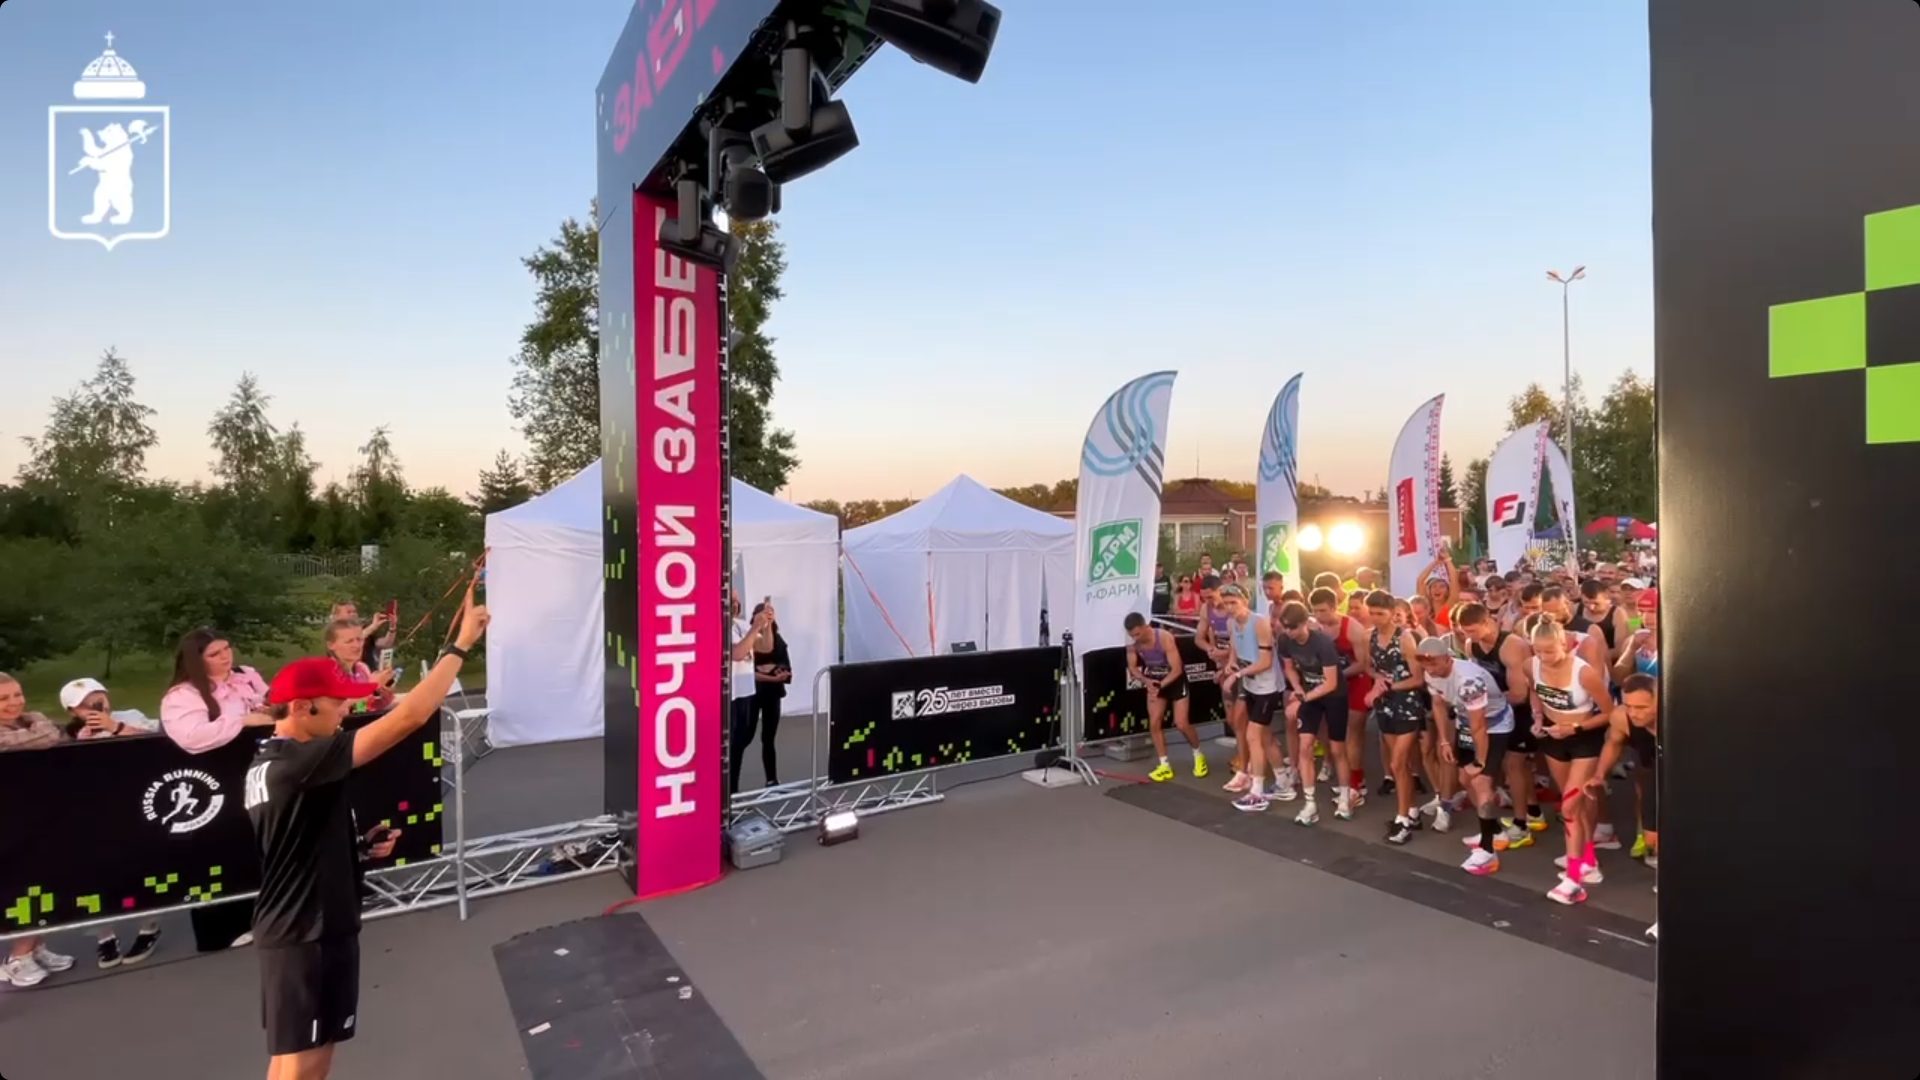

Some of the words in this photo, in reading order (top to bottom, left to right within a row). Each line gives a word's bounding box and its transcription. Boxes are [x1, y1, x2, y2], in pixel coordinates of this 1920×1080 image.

[1092, 525, 1136, 578] ФАРМ
[654, 504, 697, 819] НОЧНОЙ
[916, 686, 948, 716] 25
[950, 691, 966, 700] лет
[968, 686, 1002, 698] вместе
[950, 700, 978, 711] через
[143, 780, 164, 821] RUSSIA
[163, 768, 220, 790] RUNNING
